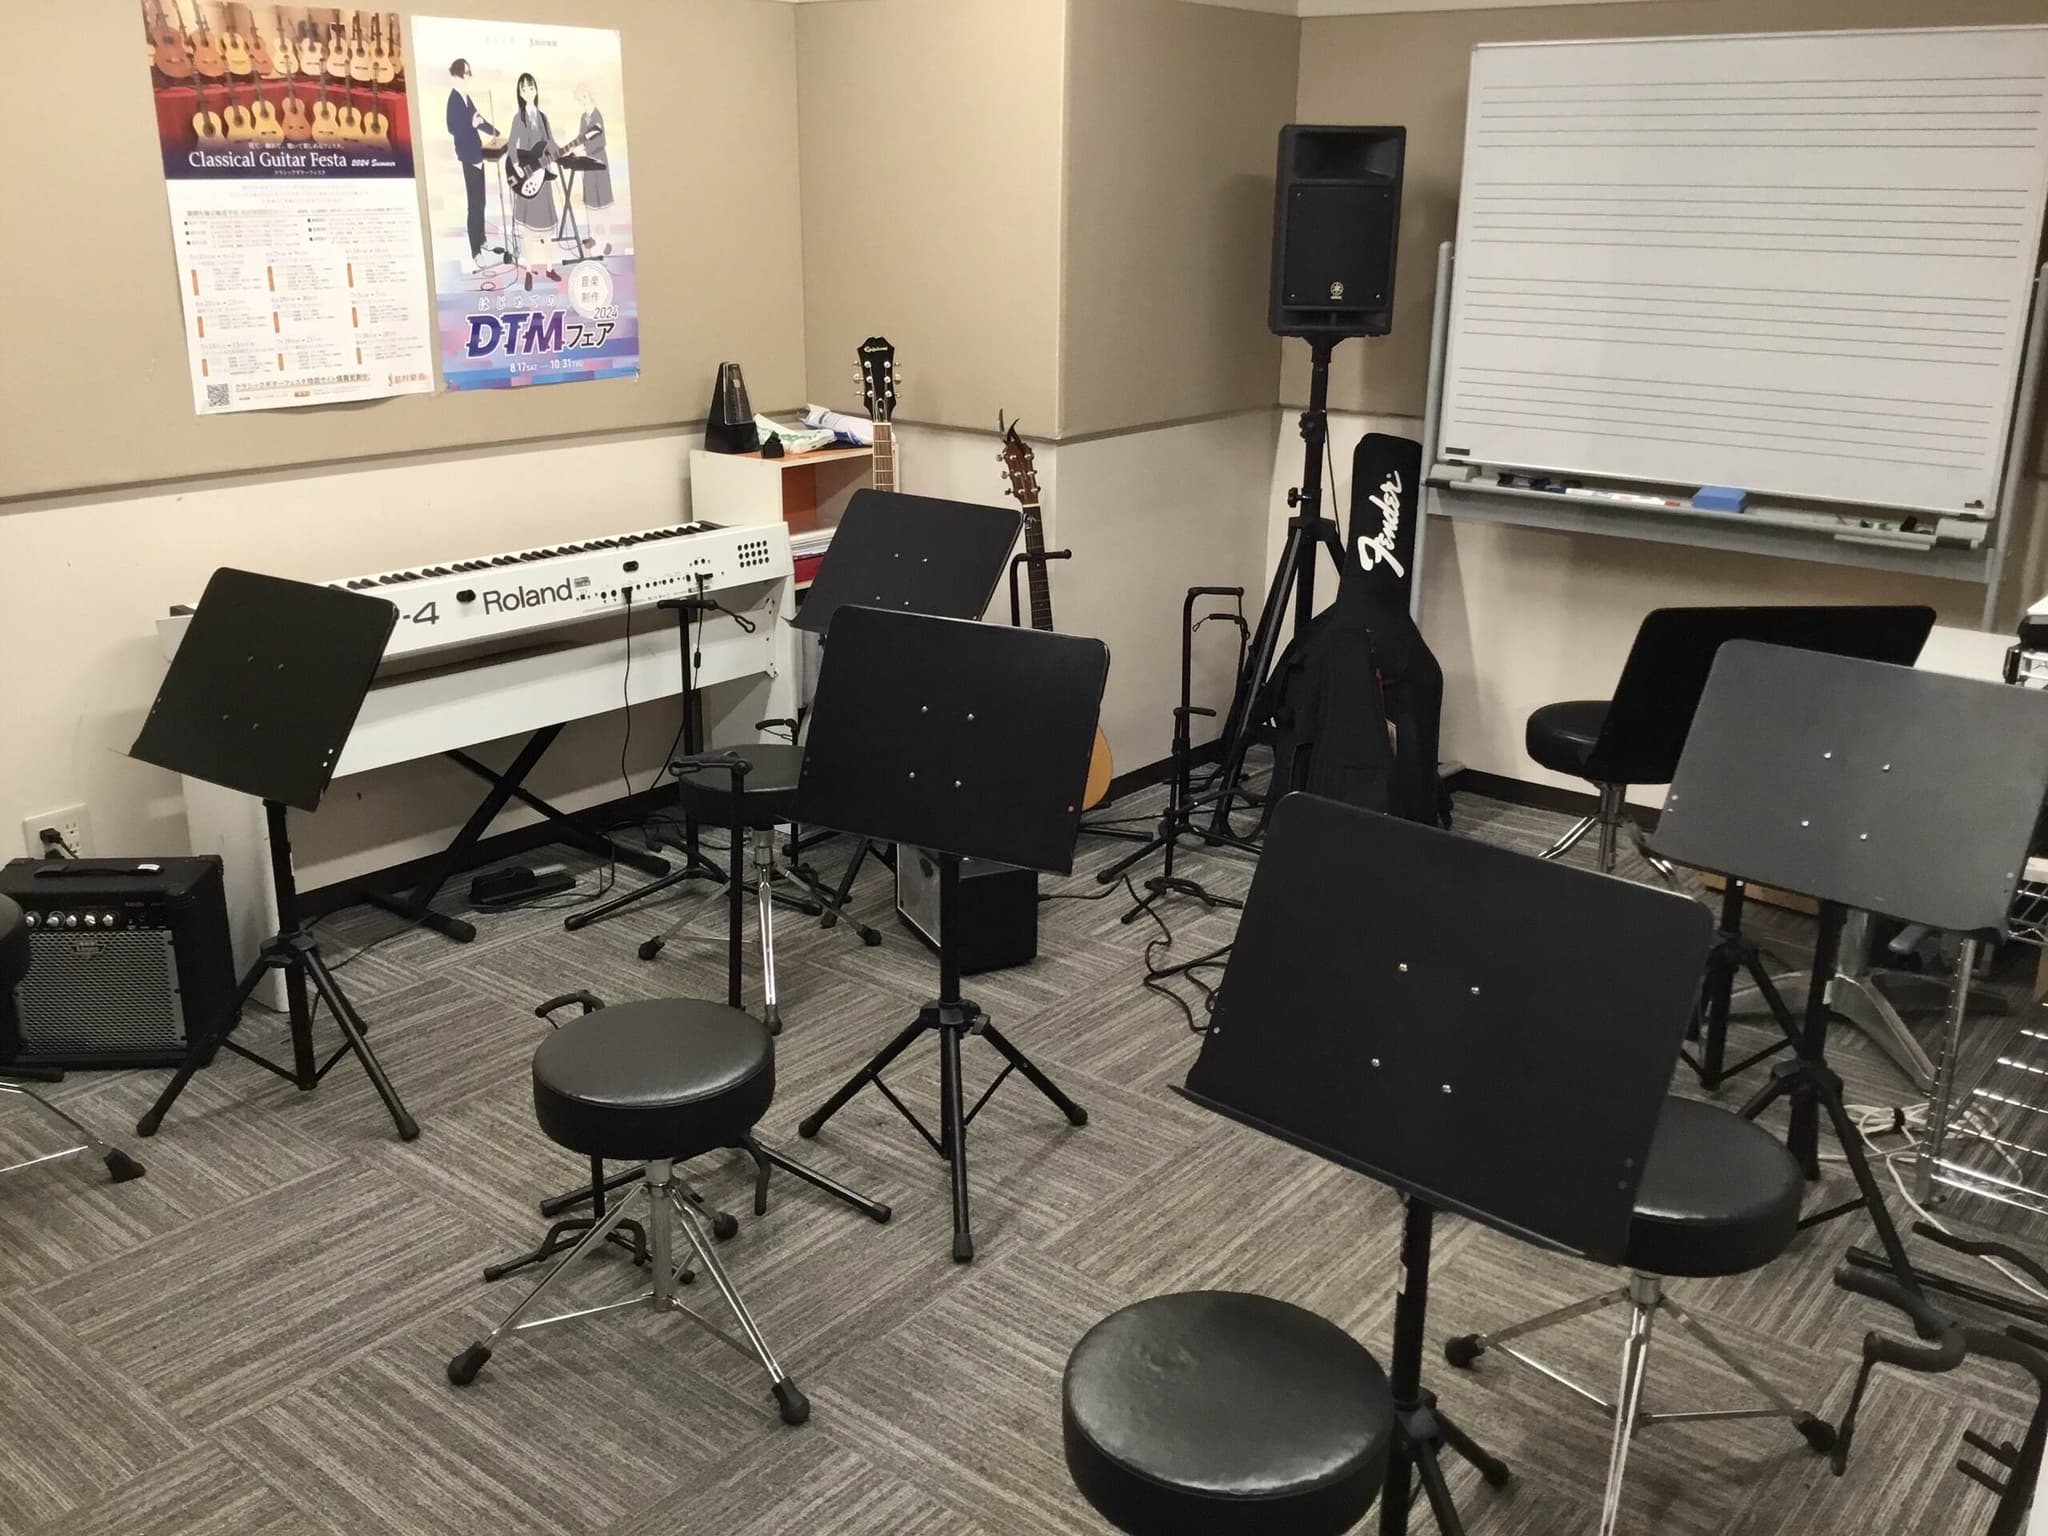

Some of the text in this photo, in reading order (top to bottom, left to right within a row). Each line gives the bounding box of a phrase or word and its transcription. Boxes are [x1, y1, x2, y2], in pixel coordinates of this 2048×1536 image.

[188, 151, 256, 168] Classical
[259, 151, 307, 168] Guitar
[309, 152, 347, 168] Festa
[351, 158, 370, 167] 2024
[593, 305, 619, 320] 2024
[1357, 470, 1405, 579] Fender
[482, 577, 573, 615] Roland
